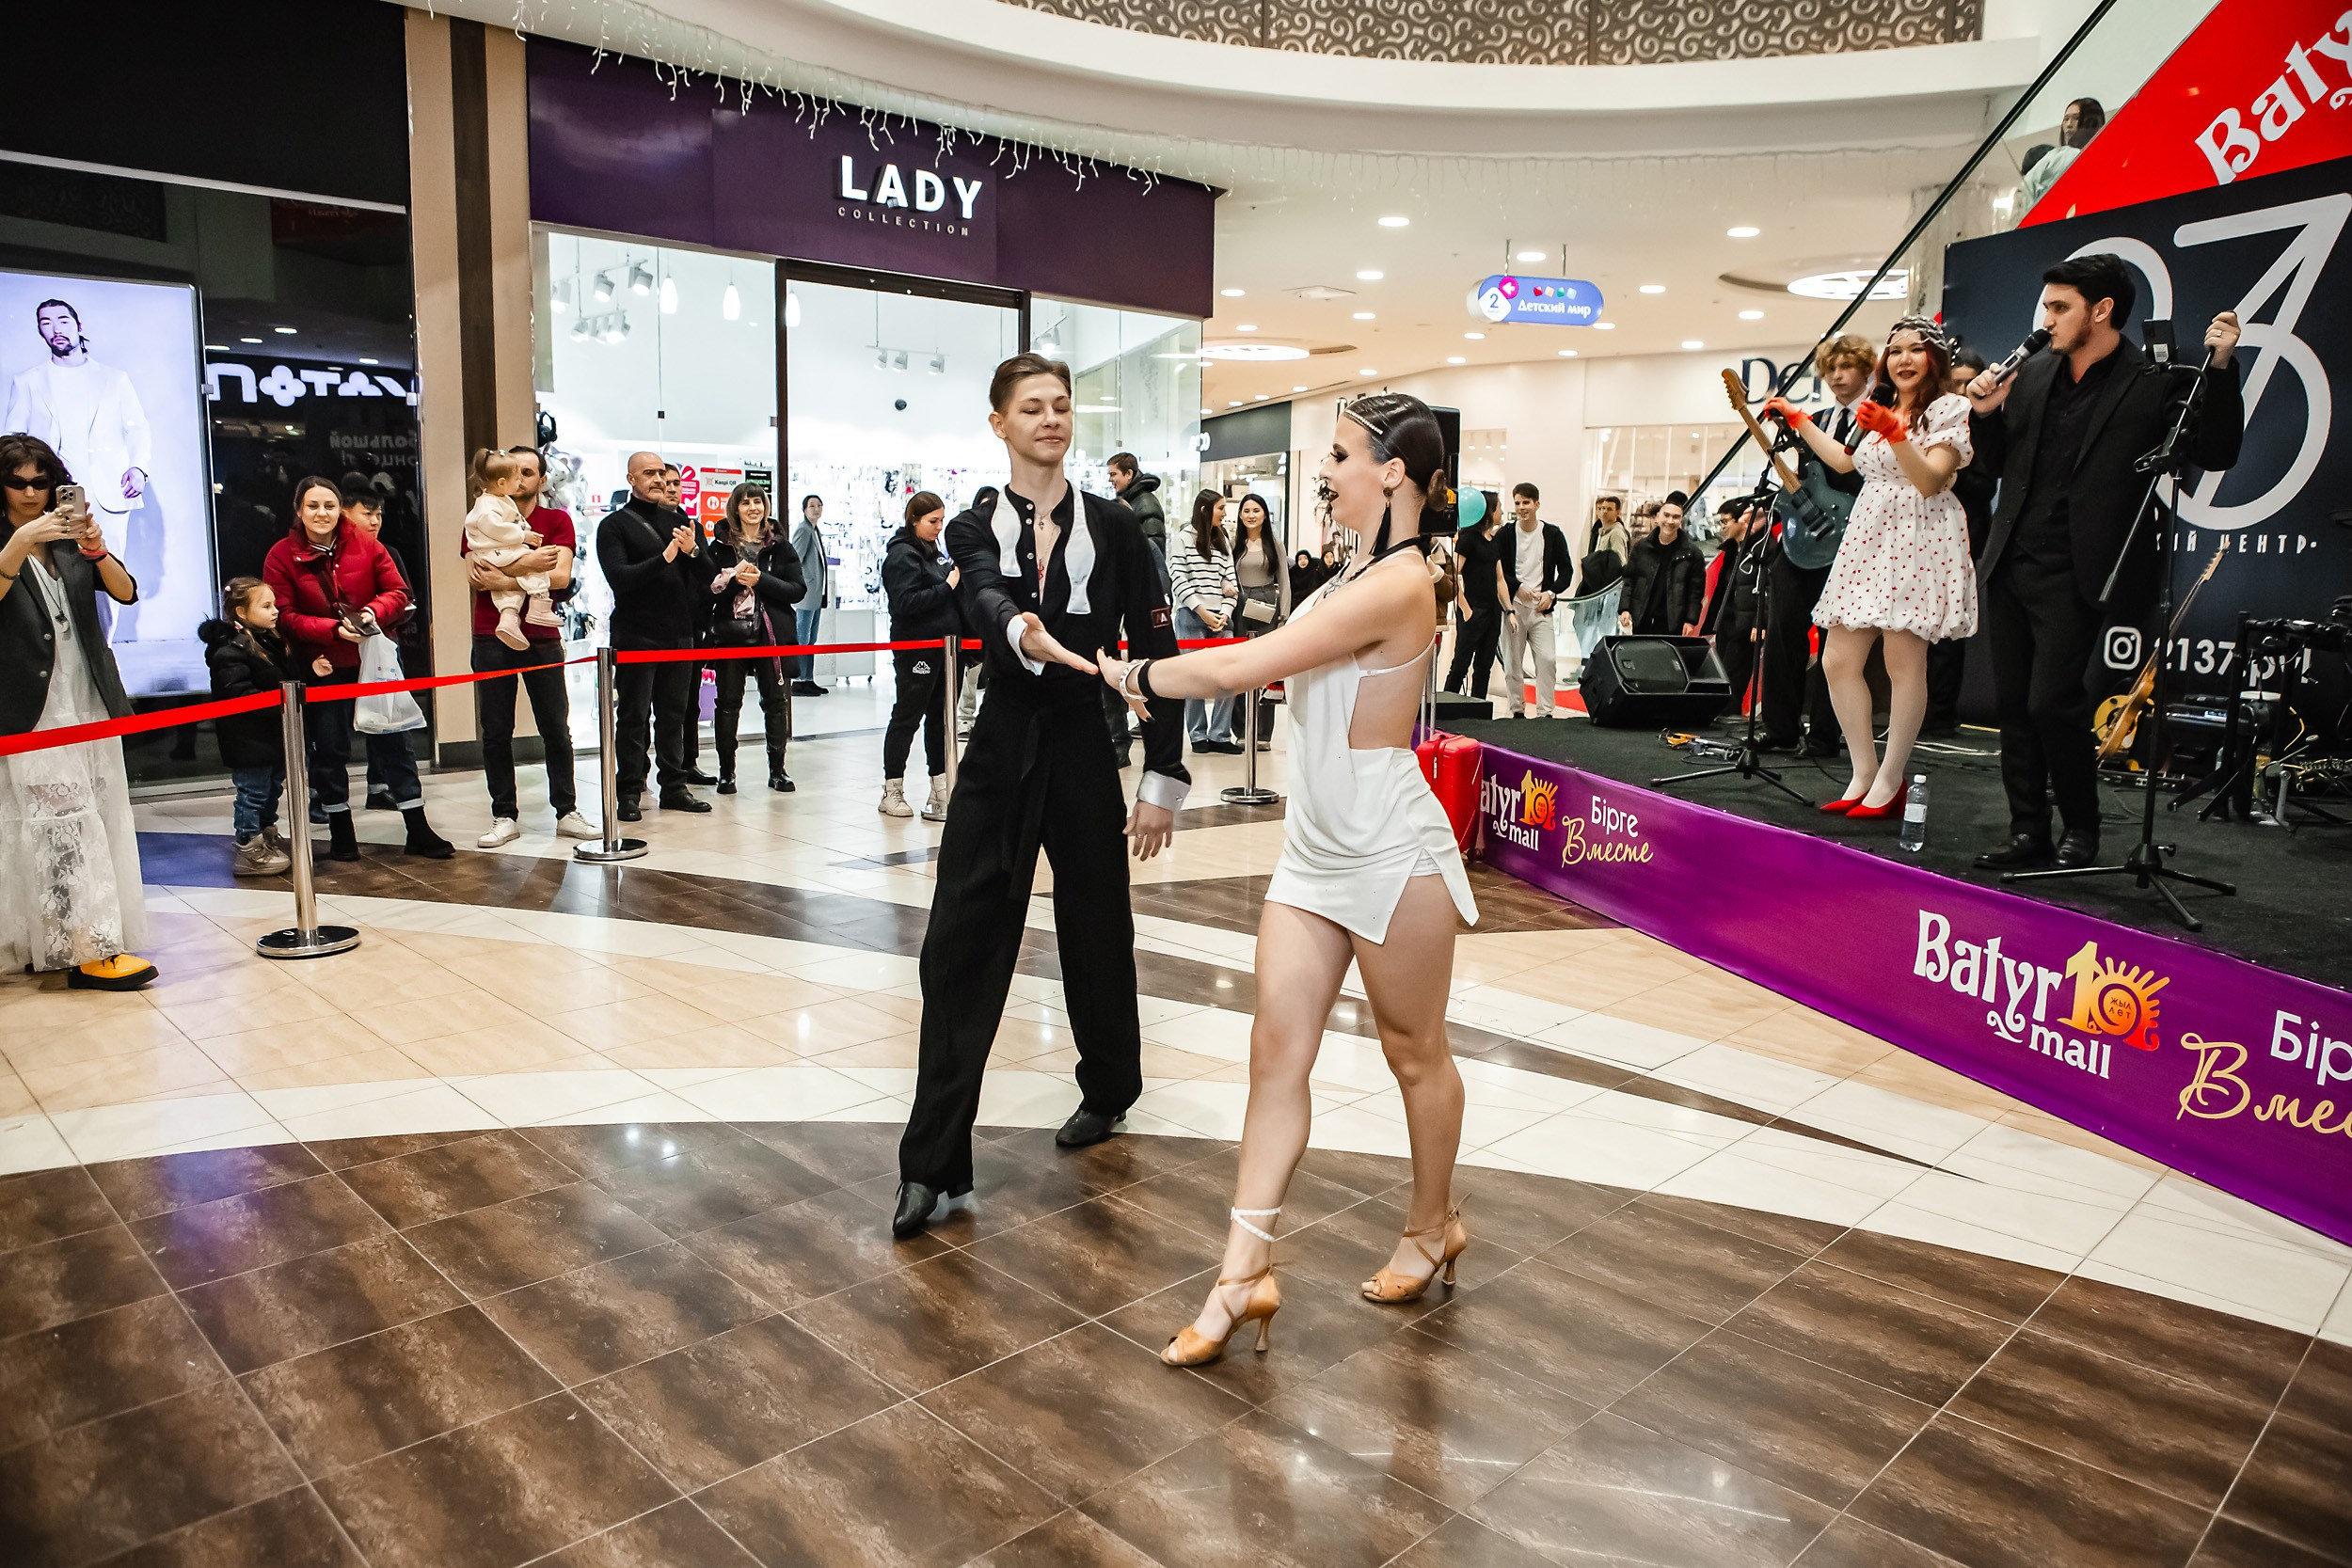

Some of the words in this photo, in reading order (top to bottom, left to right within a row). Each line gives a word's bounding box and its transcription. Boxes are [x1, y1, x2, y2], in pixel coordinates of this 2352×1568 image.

[841, 155, 982, 219] LADY
[837, 207, 968, 236] COLLECTION
[1489, 293, 1499, 309] 2
[1518, 299, 1565, 314] Детский
[1567, 304, 1591, 319] мир
[1480, 774, 1521, 832] atyr
[1591, 795, 1639, 838] Бірге
[1508, 824, 1539, 851] mall
[1561, 816, 1654, 869] Вместе
[1914, 909, 2063, 1034] Batyr
[2028, 1022, 2112, 1080] mall
